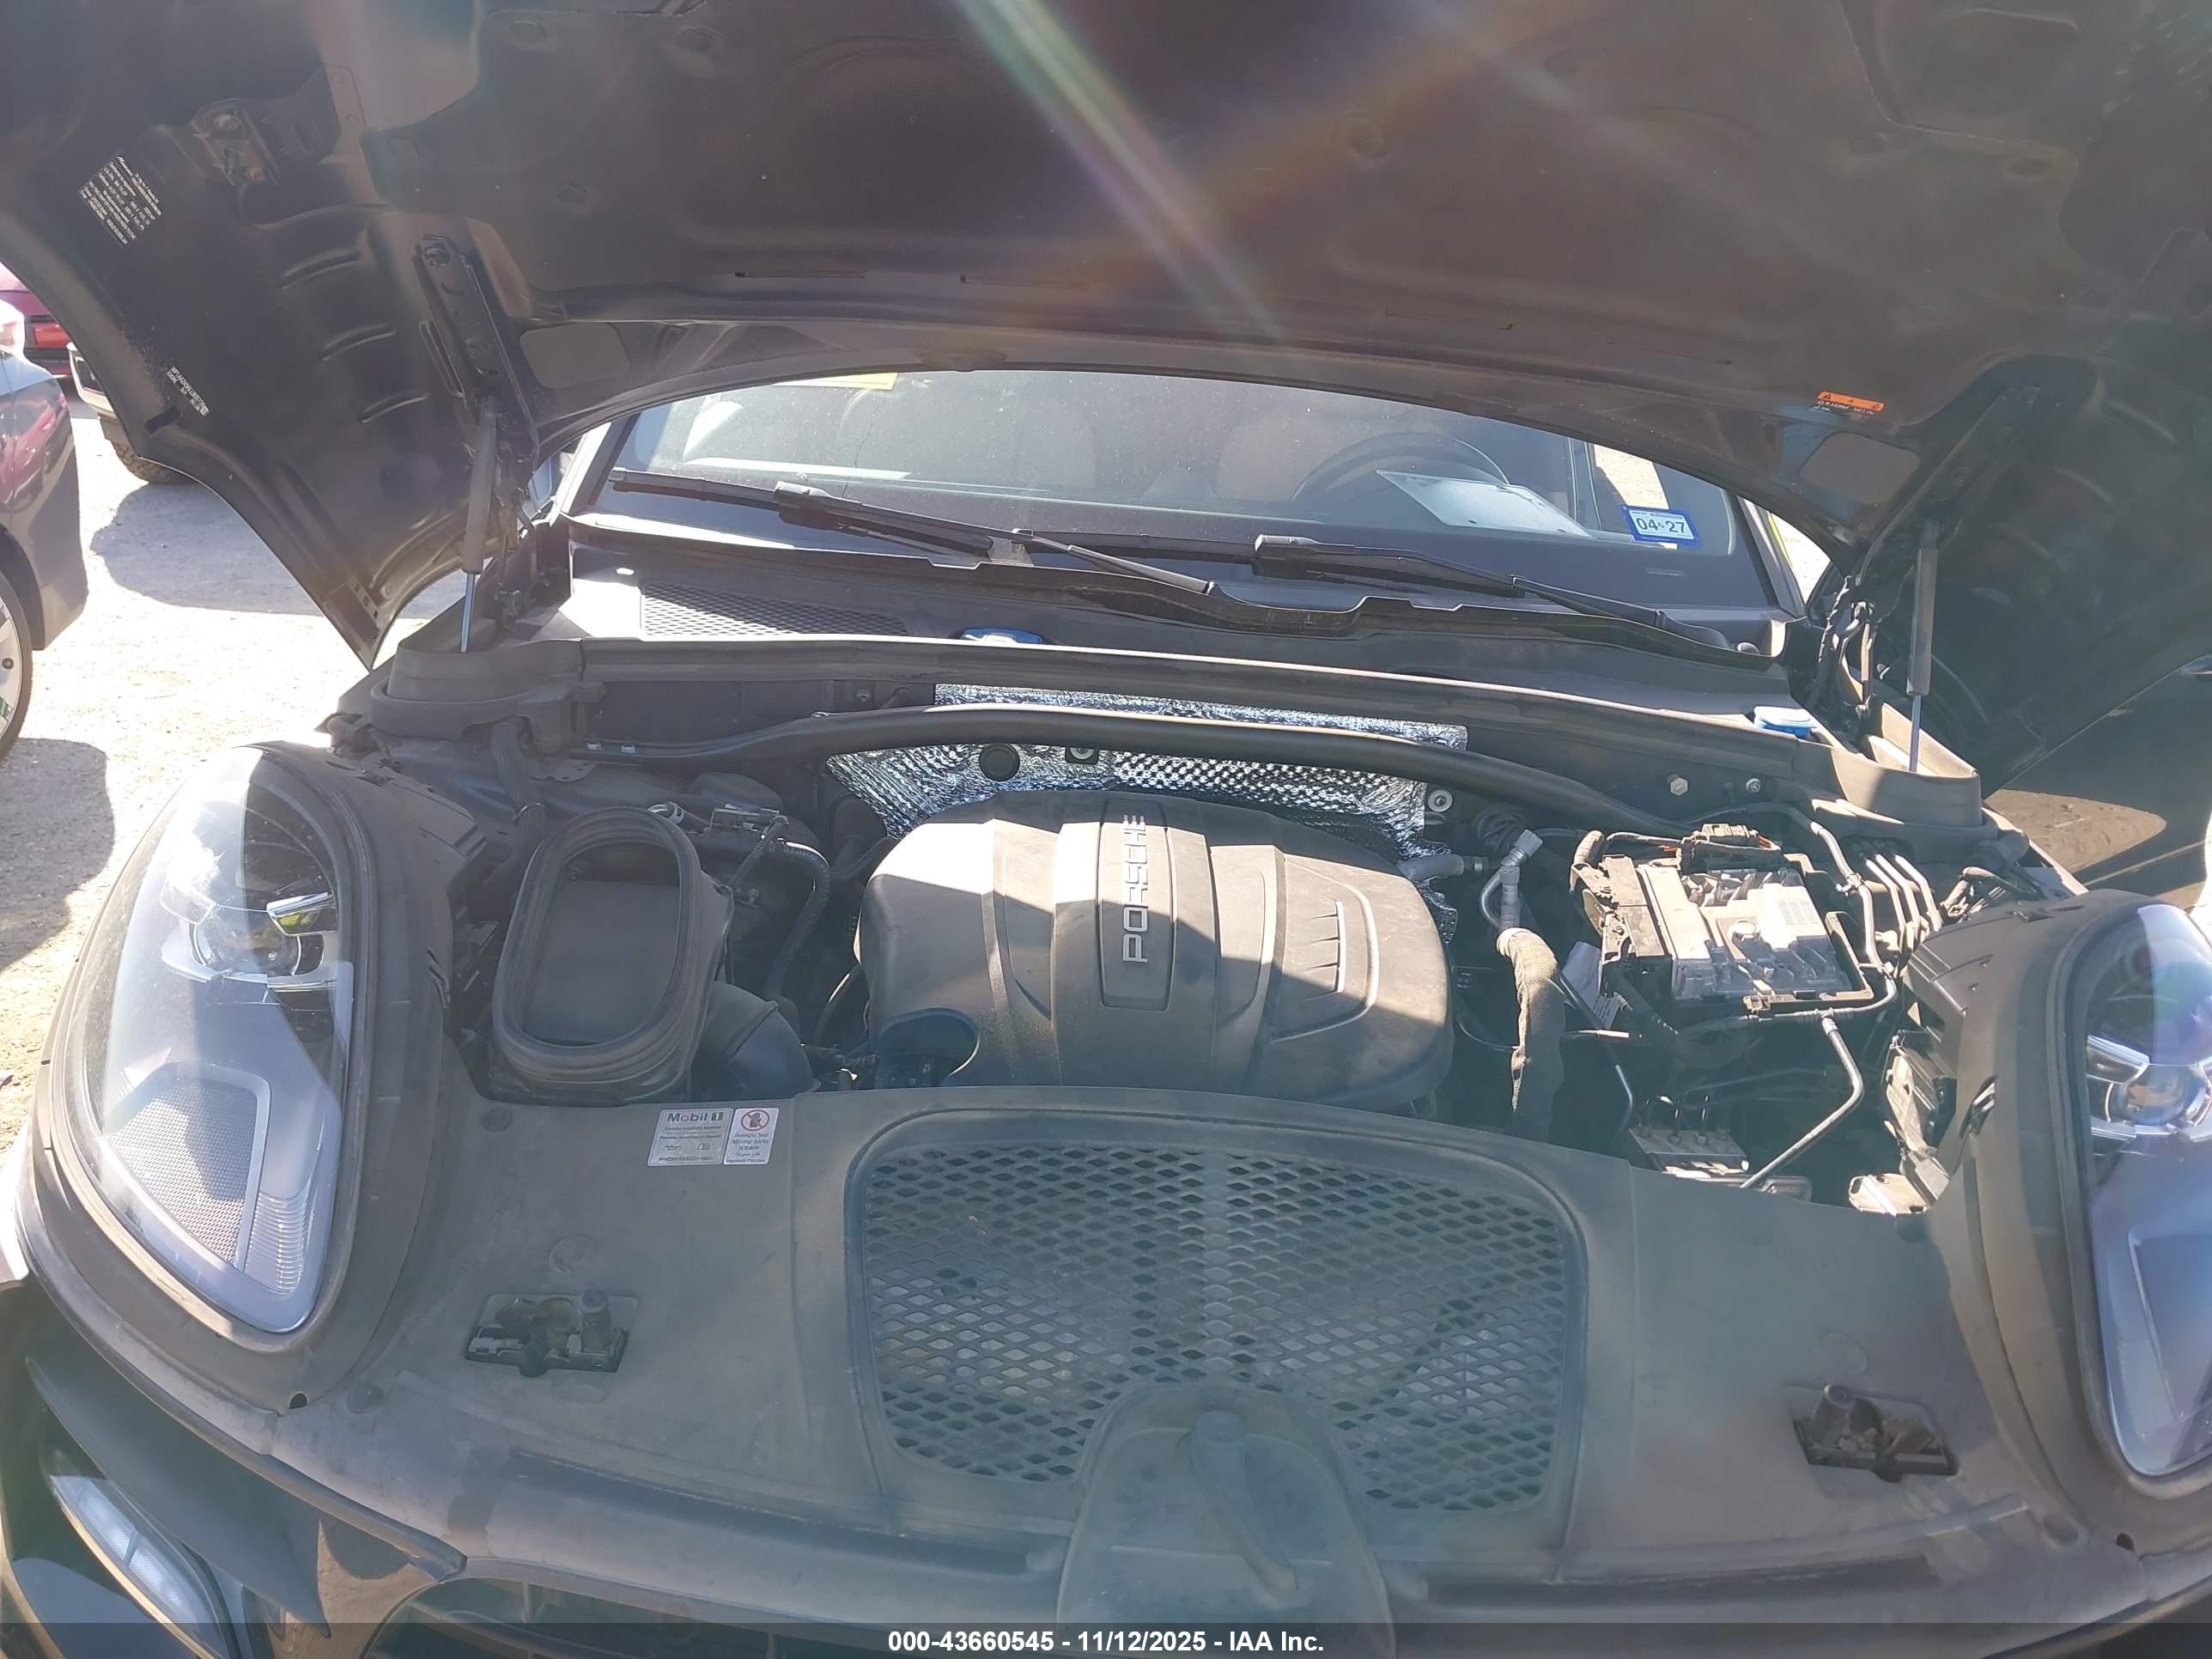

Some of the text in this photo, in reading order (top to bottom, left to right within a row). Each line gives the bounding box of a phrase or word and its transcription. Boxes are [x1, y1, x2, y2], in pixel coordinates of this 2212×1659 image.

[1636, 518, 1685, 533] 04 27
[1122, 814, 1149, 963] PORSCHE
[666, 1113, 708, 1121] Mobil
